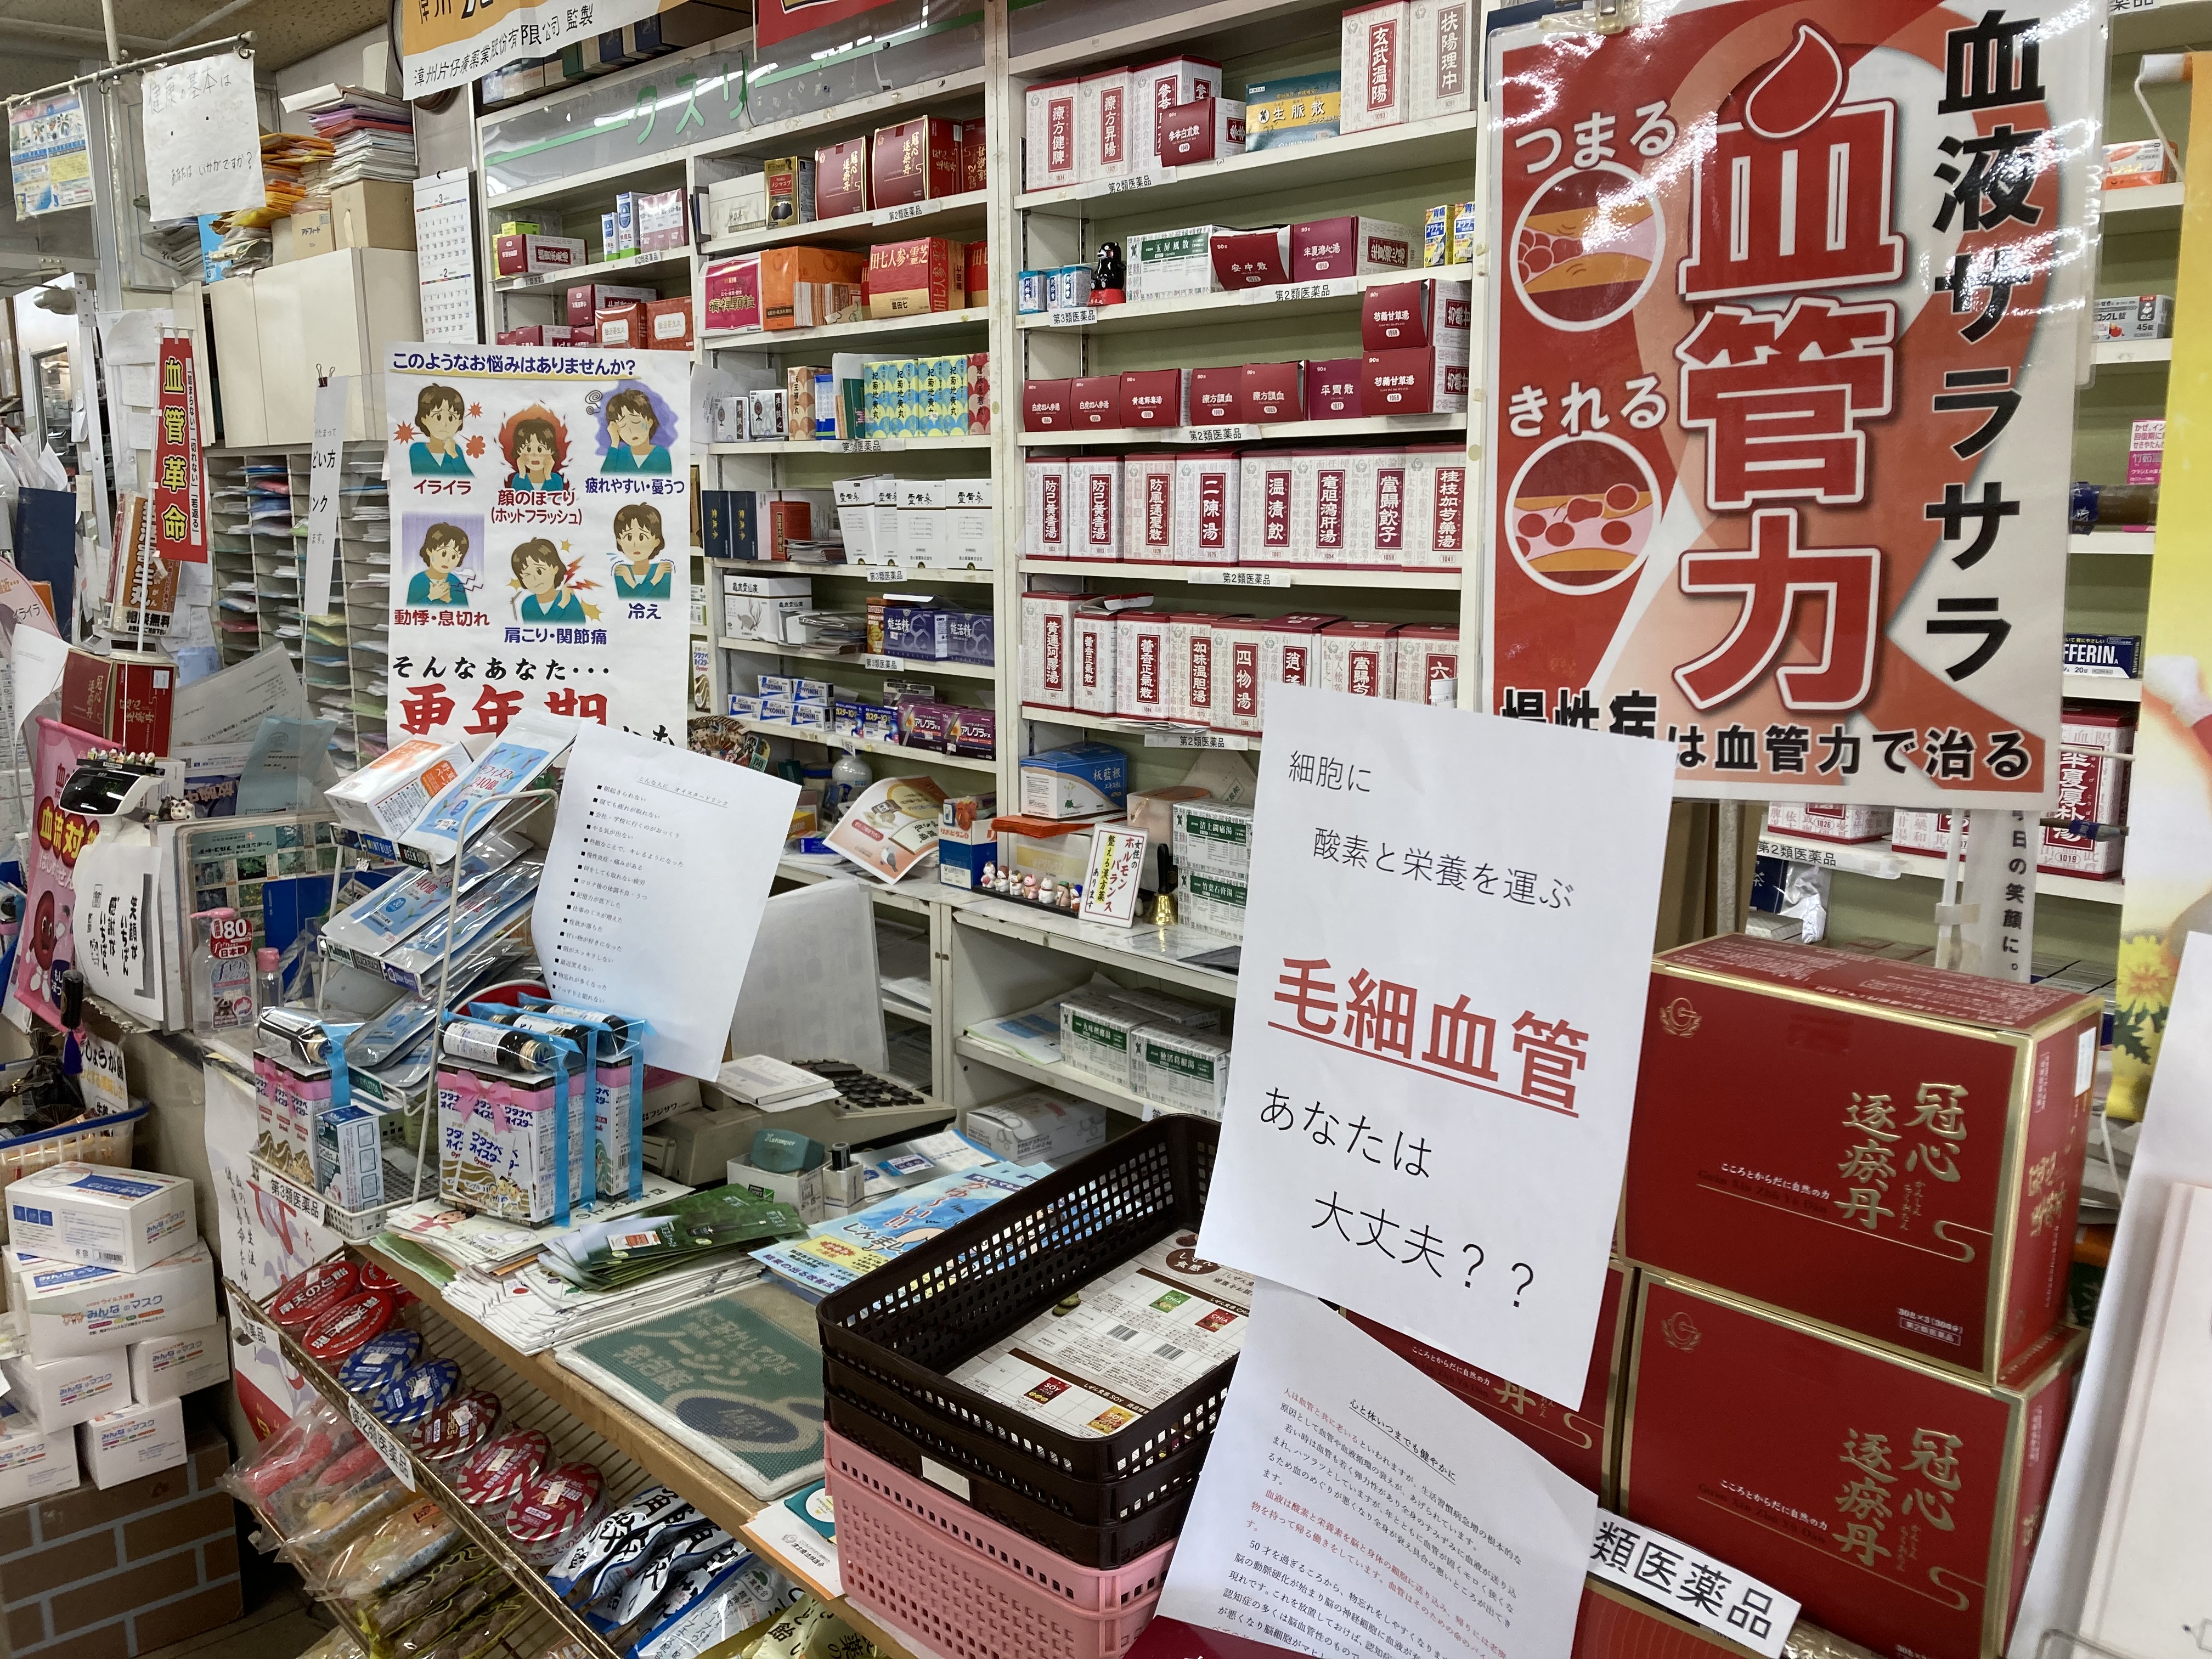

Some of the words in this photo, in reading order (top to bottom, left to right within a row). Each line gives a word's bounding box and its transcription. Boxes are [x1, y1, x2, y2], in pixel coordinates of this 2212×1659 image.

[1372, 27, 1389, 104] 玄武温陽
[1441, 12, 1458, 89] 扶陽理中
[1052, 106, 1065, 165] 療方健脾
[1104, 95, 1116, 157] 療方昇陽
[1515, 100, 1678, 174] つまる
[1108, 175, 1152, 193] 第2類医薬品
[889, 206, 923, 222] 第2類医薬品
[1275, 285, 1330, 302] 第2類医薬品
[1053, 309, 1095, 325] 第3類医薬品
[393, 353, 635, 376] このようなお悩みはありませんか？
[1923, 9, 2047, 682] 血液サラサラ
[1672, 25, 1908, 711] 血管力
[1508, 374, 1668, 437] きれる
[161, 358, 188, 540] 血管革命
[1189, 428, 1241, 442] 第2類医薬品
[413, 481, 471, 494] イライラ
[498, 489, 576, 506] 顔のほてり
[585, 478, 685, 494] 疲れやすい・憂うつ
[491, 508, 582, 526] (ホットフラッシュ)
[1149, 478, 1164, 541] 防風通聖散
[1203, 480, 1220, 540] 二陳湯
[1267, 477, 1285, 540] 温清飲
[870, 571, 903, 581] 第3類医薬品
[1223, 572, 1271, 585] 第2類医薬品
[394, 610, 490, 627] 動悸・息切れ
[628, 603, 662, 620] 冷え
[504, 627, 607, 645] 肩こり・関節痛
[1047, 621, 1059, 684] 黄連阿膠湯
[2064, 644, 2115, 665] FFERIN
[866, 659, 898, 669] 第3類医薬品
[1193, 641, 1207, 703] 加味温胆湯
[1237, 650, 1252, 709] 四物湯
[399, 684, 607, 737] 更年期
[961, 726, 991, 739] アレグラFX
[1180, 736, 1224, 748] 第2類医薬品
[638, 776, 669, 789] こんな人に
[1093, 767, 1121, 782] 板藍根
[1289, 750, 1372, 794] 細胞に
[1816, 819, 1831, 829] 1026
[1097, 834, 1115, 901] 整える漢方薬
[1118, 837, 1135, 890] ホルモン
[1131, 839, 1142, 869] 女性の
[1313, 827, 1573, 910] 酸素と栄養を運ぶ
[1758, 841, 1837, 866] 第2類医薬品
[2058, 854, 2077, 863] 1019
[1086, 868, 1099, 910] あります
[1104, 859, 1121, 913] バランス
[1273, 957, 1590, 1110] 毛細血管
[505, 1106, 533, 1119] ワタナベ
[472, 1132, 504, 1155] ワタナベ
[1260, 1087, 1432, 1178] あなたは
[1903, 1082, 1968, 1182] 冠心
[470, 1143, 501, 1164] オイスター
[270, 1178, 319, 1219] 第3類医薬品
[1722, 1163, 1830, 1200] こころとからだに自然の力
[1311, 1191, 1535, 1309] 大丈夫？？
[1412, 1346, 1491, 1386] こころとからだに自然の力
[1043, 1383, 1061, 1393] SOY
[1107, 1414, 1124, 1423] SOY
[1350, 1398, 1455, 1481] 心と体いつまでも健やかに
[1263, 1469, 1283, 1487] ます。
[1900, 1427, 1964, 1531] 冠心
[1720, 1480, 1829, 1532] こころとからだに自然の力
[1590, 1521, 1773, 1640] 類医薬品
